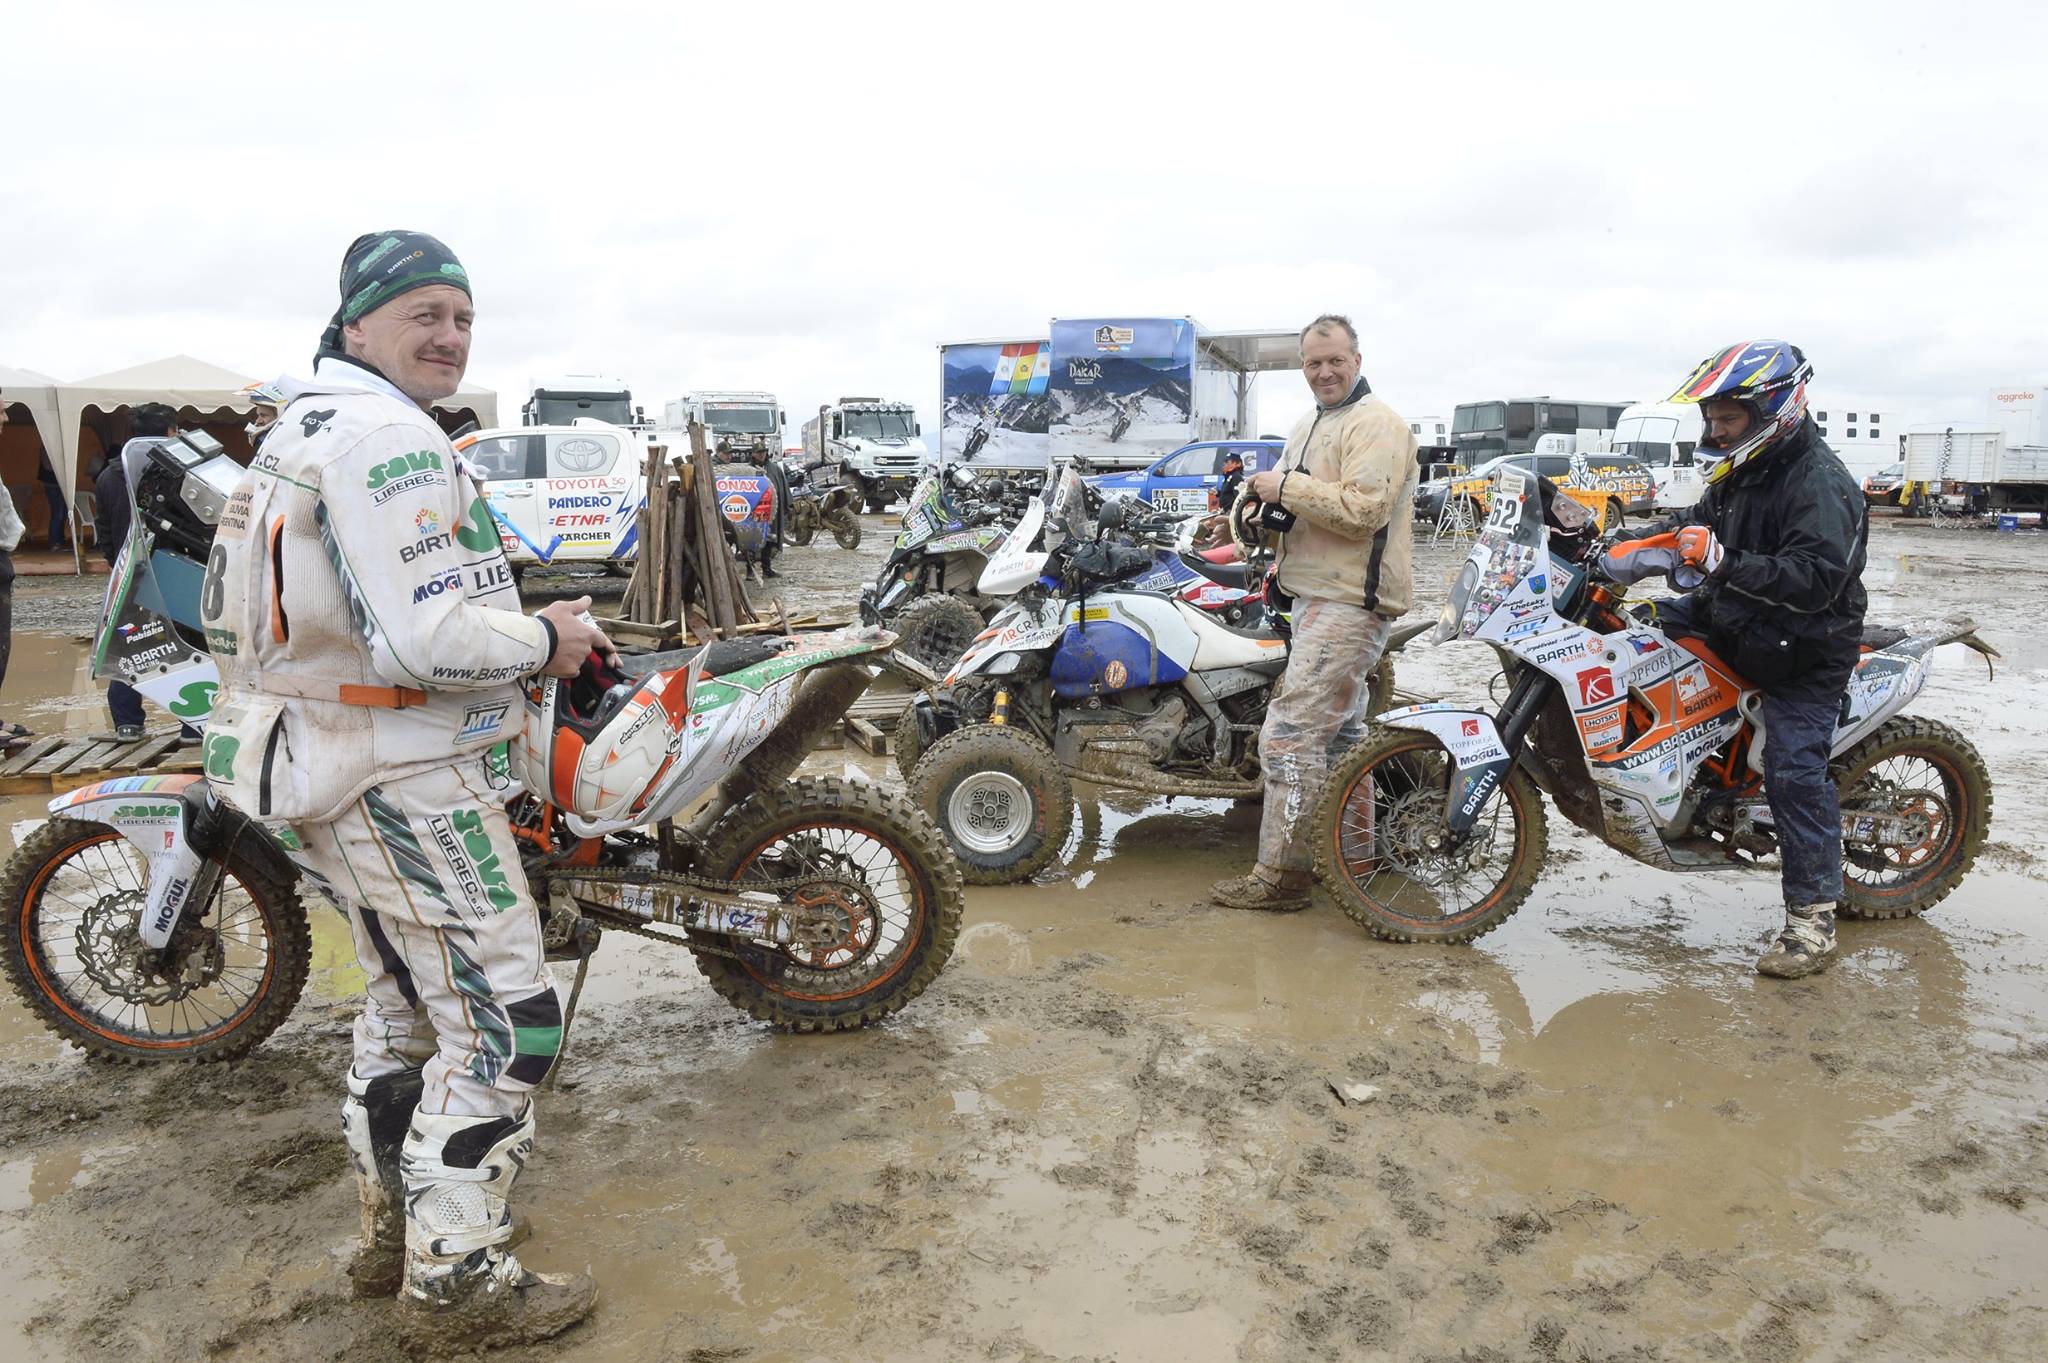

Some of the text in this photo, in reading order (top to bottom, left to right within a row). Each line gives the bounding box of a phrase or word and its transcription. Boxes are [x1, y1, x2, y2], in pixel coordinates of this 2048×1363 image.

[1997, 391, 2034, 403] aggreko
[373, 473, 434, 503] LIBEREC
[546, 478, 608, 491] TOYOTA
[549, 495, 612, 509] PANDERO
[725, 504, 748, 513] Gulf
[1153, 498, 1179, 513] 348
[555, 514, 605, 527] ETNA
[1490, 497, 1517, 530] 62
[1143, 573, 1175, 590] YAMAHA
[131, 641, 179, 665] BARTH
[1536, 642, 1585, 664] BARTH
[136, 658, 161, 673] RACING
[1616, 648, 1683, 689] TOPFOREX
[1684, 690, 1723, 716] BARTH
[1584, 713, 1618, 728] LHOTSKY
[1593, 736, 1618, 748] BARTH
[1685, 734, 1726, 765] MOGUL
[1460, 748, 1502, 766] MOGUL
[1462, 769, 1498, 816] BARTH
[430, 817, 479, 895] LIBEREC
[153, 878, 188, 933] MOGUL
